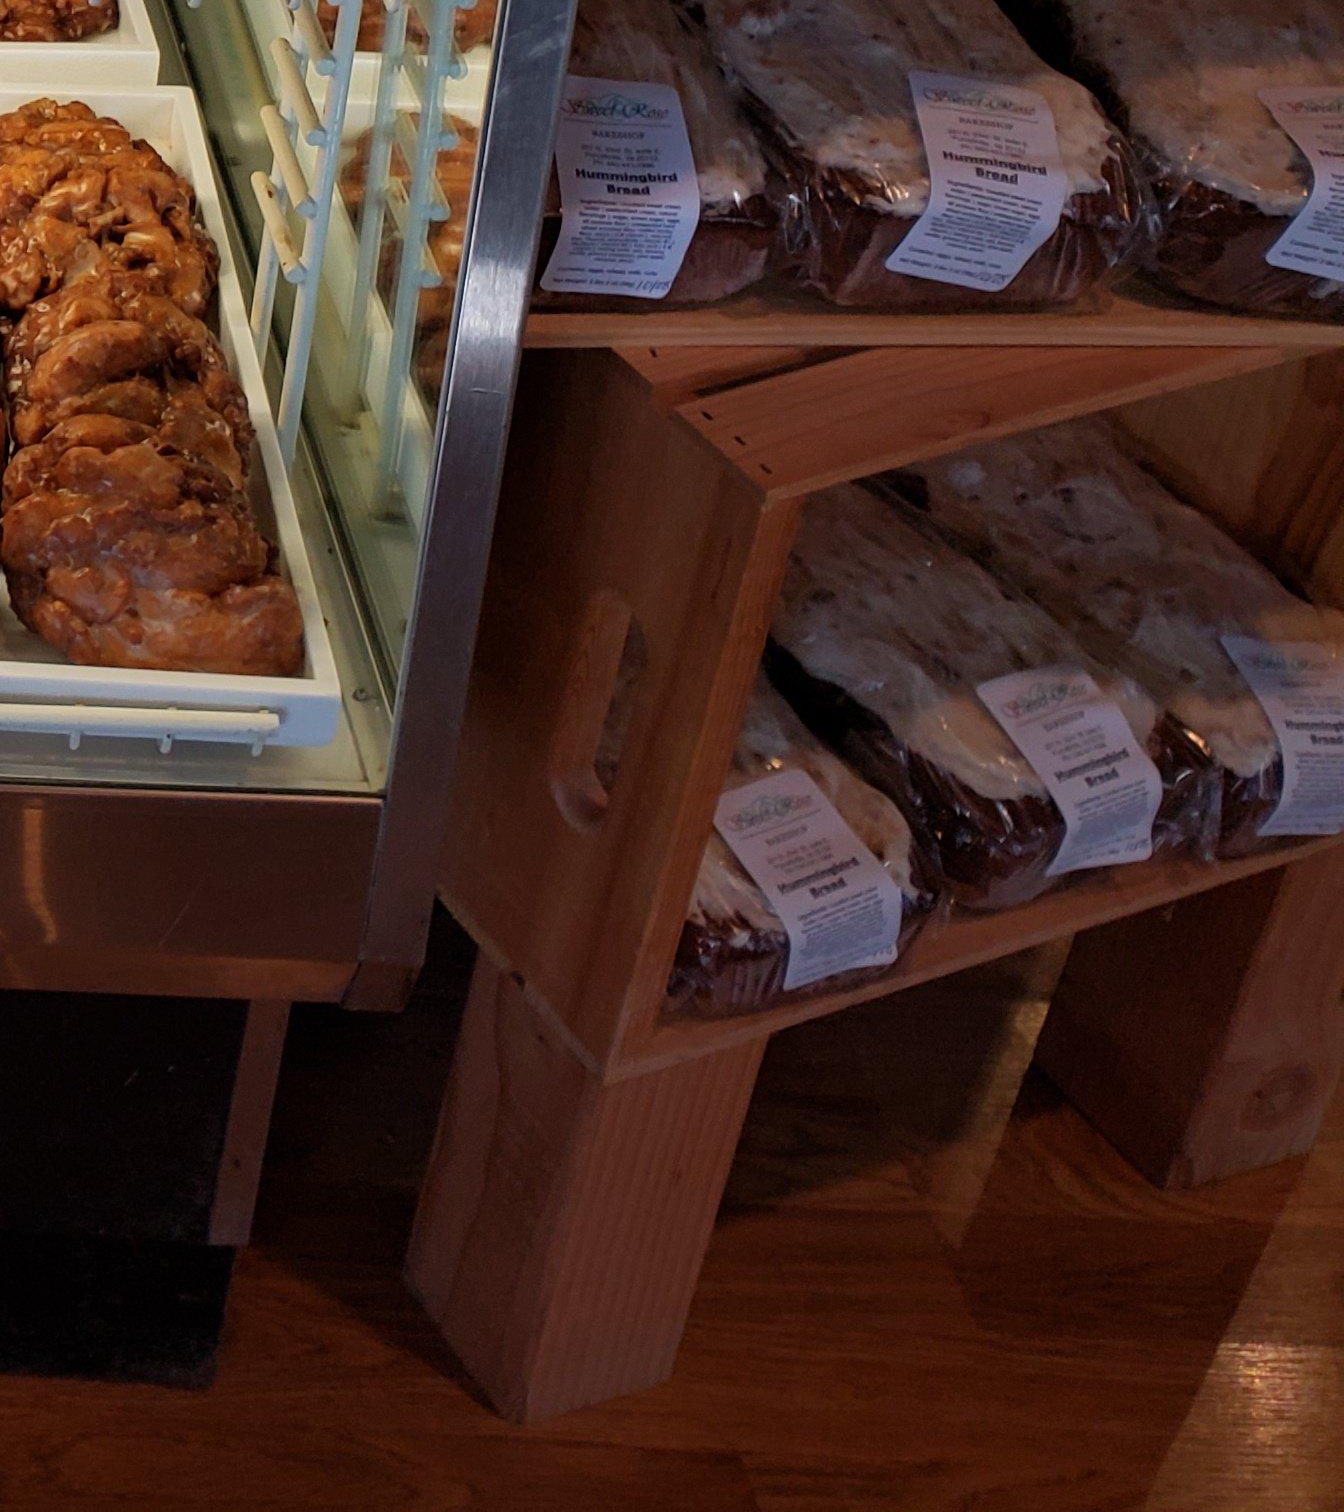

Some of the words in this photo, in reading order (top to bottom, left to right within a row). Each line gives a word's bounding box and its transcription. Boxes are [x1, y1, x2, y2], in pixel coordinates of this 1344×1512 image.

[941, 150, 1048, 177] Hummingbird
[574, 167, 679, 184] Hummingbird
[975, 167, 1019, 185] Bread
[606, 184, 651, 196] Bread
